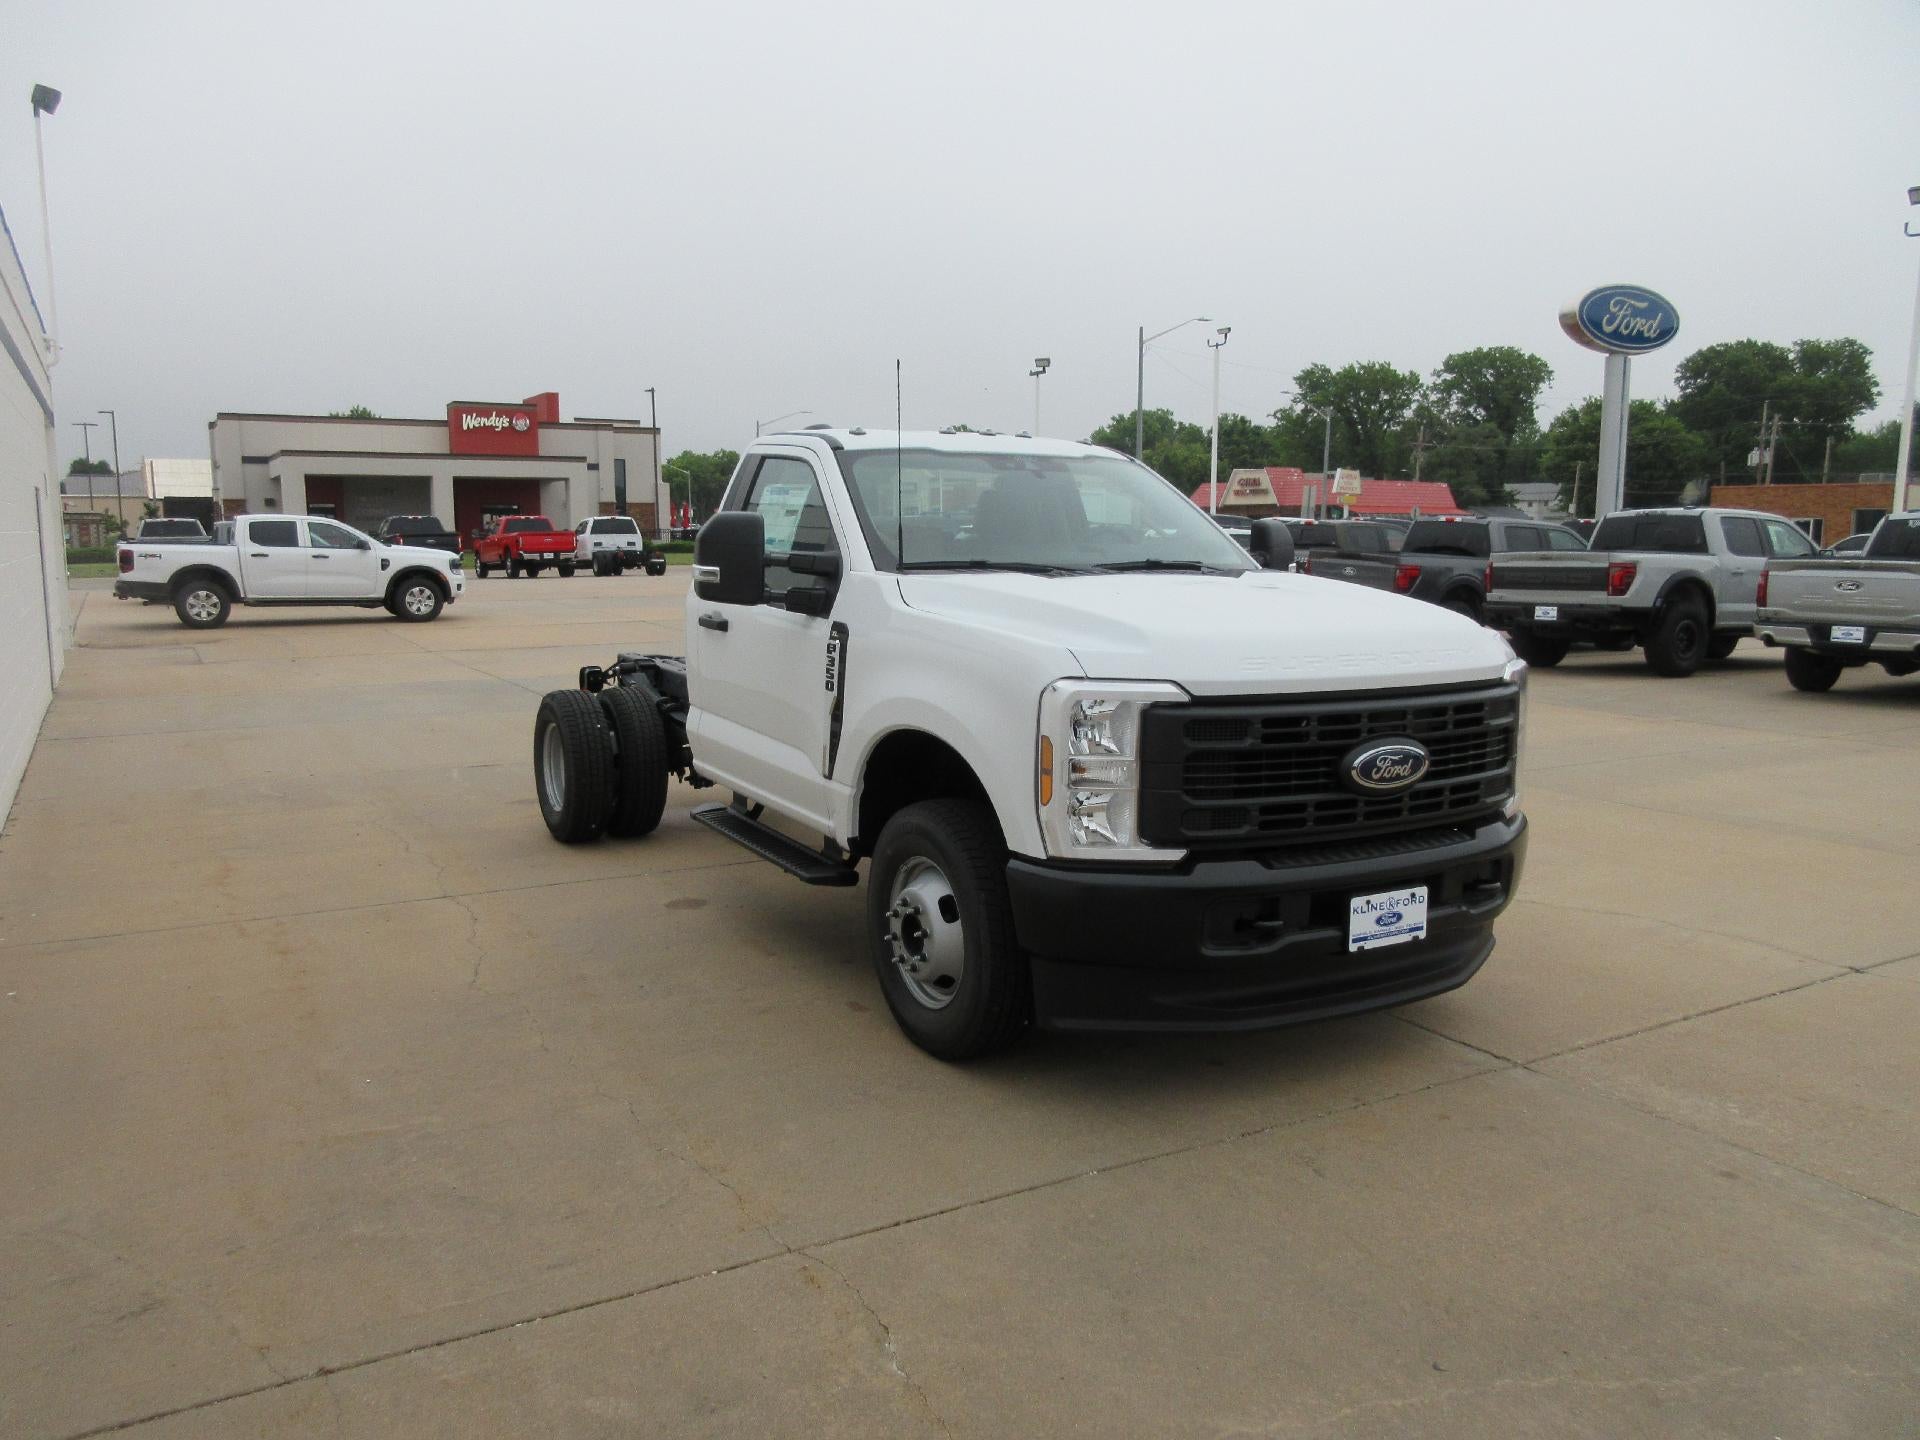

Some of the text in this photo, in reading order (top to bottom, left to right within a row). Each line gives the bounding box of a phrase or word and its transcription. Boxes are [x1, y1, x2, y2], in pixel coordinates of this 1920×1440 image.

[1602, 296, 1662, 338] Ford
[462, 411, 510, 431] Wendy's
[1372, 755, 1413, 779] Ford
[1353, 902, 1386, 915] KLINE
[1396, 895, 1424, 908] FORD
[1378, 913, 1398, 925] Ford
